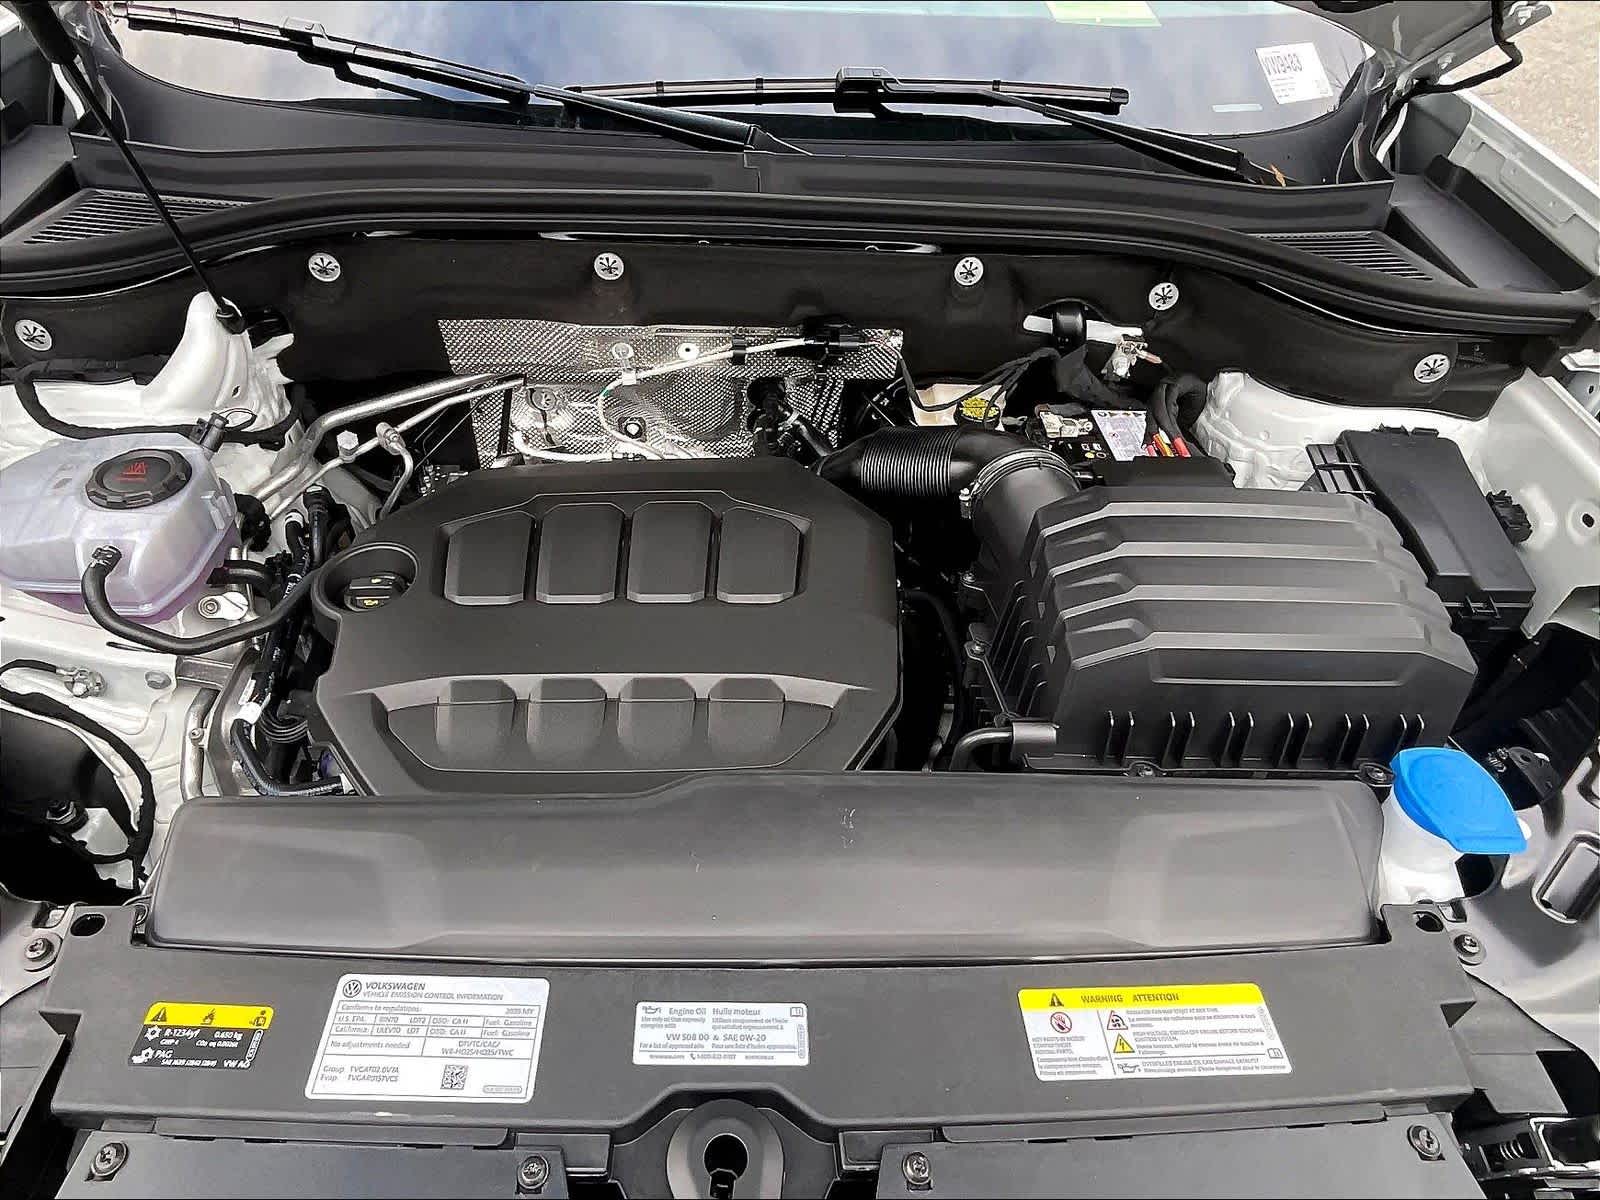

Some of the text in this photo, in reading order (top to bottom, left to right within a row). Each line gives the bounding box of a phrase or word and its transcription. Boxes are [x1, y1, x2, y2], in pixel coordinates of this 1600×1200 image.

[365, 981, 426, 991] VOLKSWAGEN
[363, 990, 389, 998] VEHICLE
[424, 992, 455, 1000] CONTROL
[456, 993, 504, 1001] INFORMATION
[1080, 992, 1180, 1004] WARNING ATTENTION
[669, 1007, 707, 1016] Engine Oil
[733, 1008, 761, 1016] moteur
[164, 1028, 200, 1039] R-1234yf
[666, 1033, 681, 1041] VW
[682, 1033, 697, 1041] 508
[698, 1033, 710, 1041] 00
[722, 1033, 738, 1042] SAE
[739, 1033, 767, 1042] 0W-20
[330, 1040, 341, 1048] No
[384, 1041, 411, 1049] needed
[154, 1049, 173, 1058] PAG
[223, 1060, 237, 1068] VW
